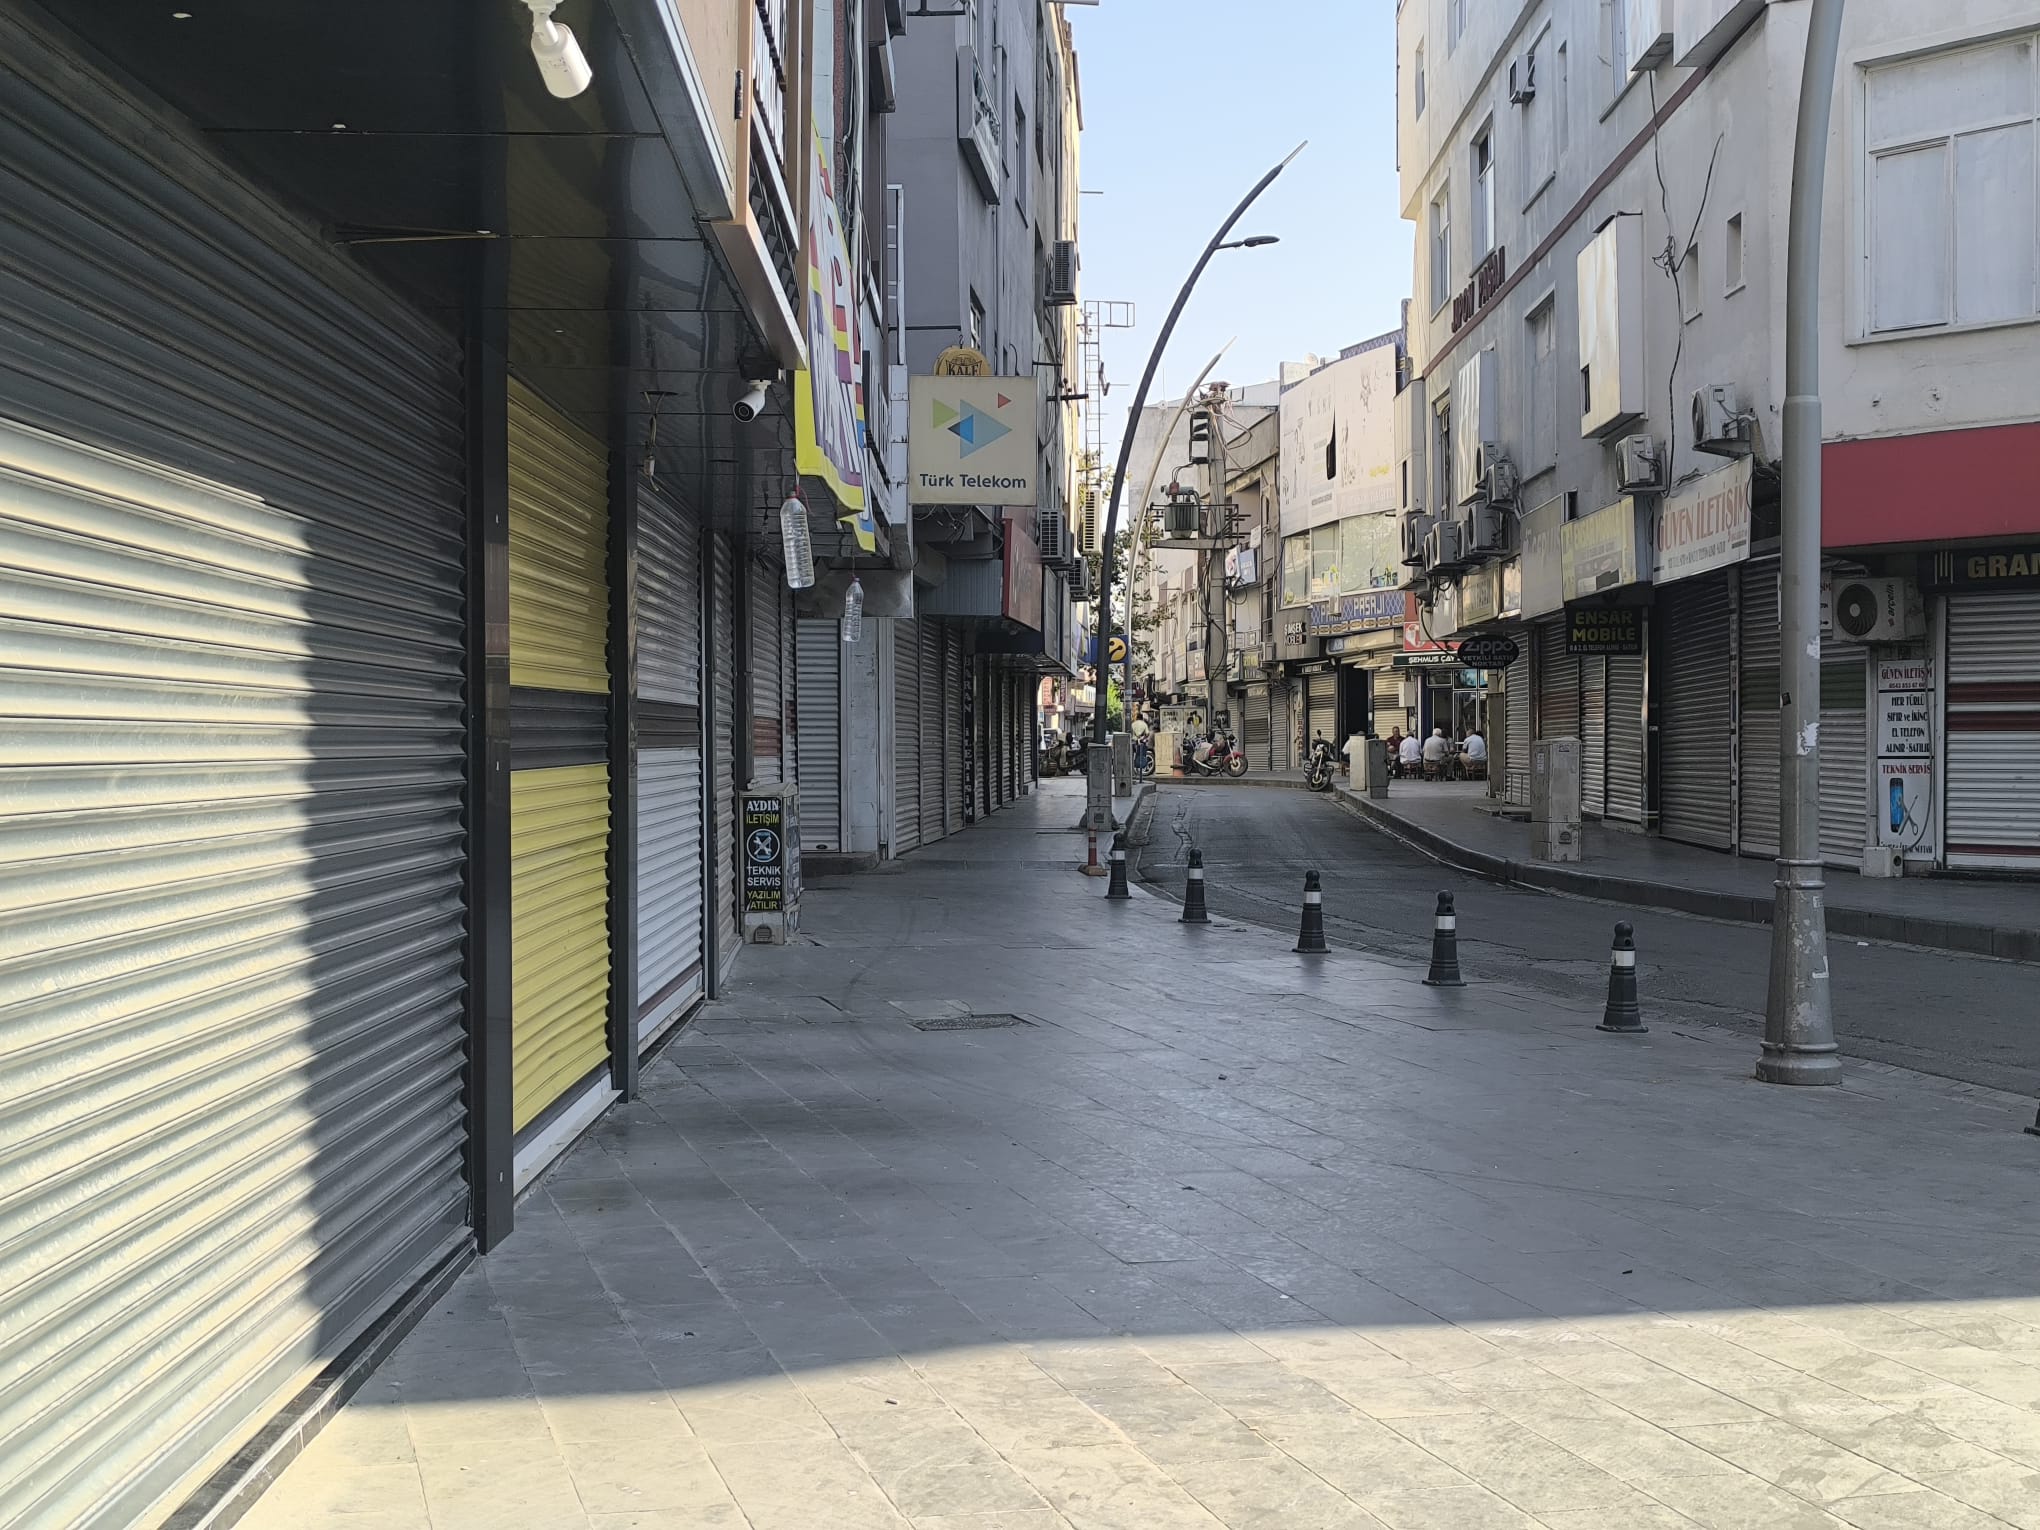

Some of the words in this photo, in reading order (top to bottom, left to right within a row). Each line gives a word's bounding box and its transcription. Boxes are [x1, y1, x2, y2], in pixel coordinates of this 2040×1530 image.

[920, 473, 954, 487] Türk
[959, 474, 1026, 489] Telekom
[1656, 502, 1693, 553] GÜVEN
[1696, 475, 1748, 542] İLETİŞİM
[1353, 594, 1385, 617] PASAJI
[1887, 583, 1895, 617] arçelik
[1575, 609, 1632, 625] ENSAR
[1440, 655, 1455, 664] ÇAY
[1881, 665, 1903, 680] GÜVEN
[1904, 664, 1933, 682] İLETİŞM
[1891, 695, 1904, 706] HER
[1906, 693, 1925, 706] TÜRLÜ
[1887, 712, 1903, 722] SIFIR
[1904, 713, 1911, 722] ve
[1891, 728, 1898, 737] EL
[1900, 727, 1925, 738] TELEFON
[1885, 743, 1906, 753] ALINIR
[1882, 762, 1907, 775] TEKNİK
[1908, 762, 1931, 775] SERVİS
[746, 800, 779, 812] AYDIN
[746, 811, 780, 827] İLETİŞİM
[750, 901, 778, 910] ATILIR
